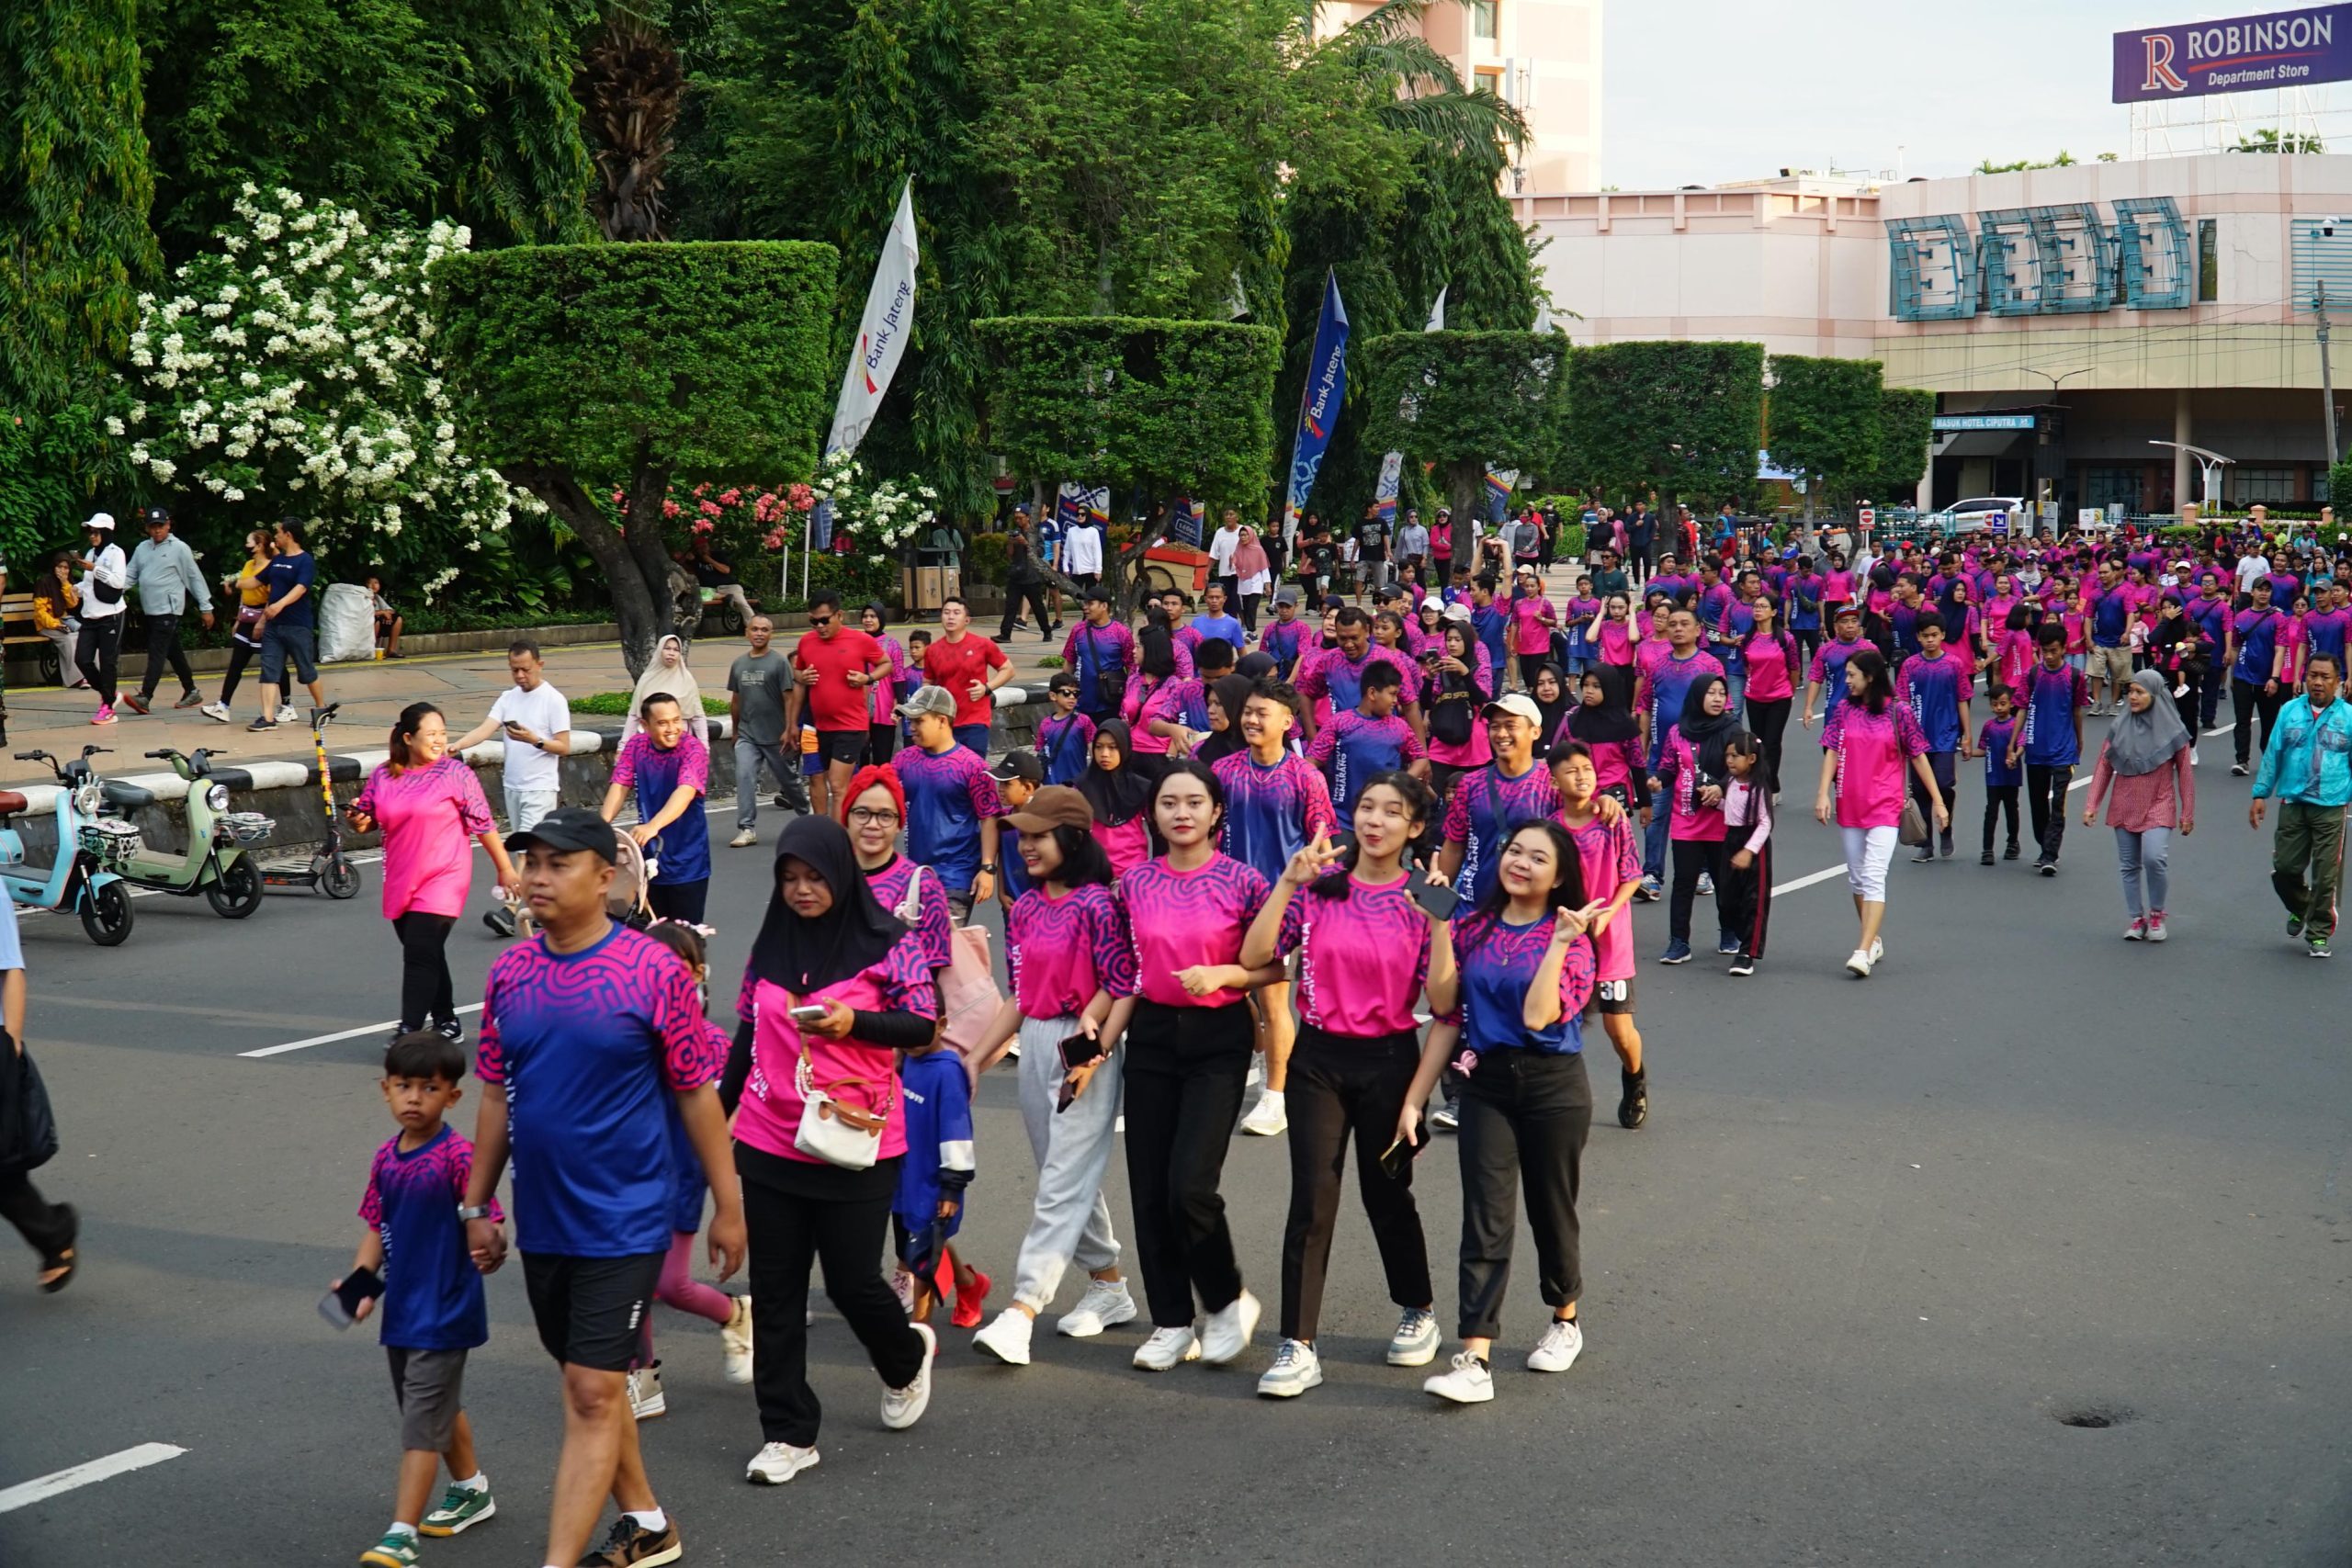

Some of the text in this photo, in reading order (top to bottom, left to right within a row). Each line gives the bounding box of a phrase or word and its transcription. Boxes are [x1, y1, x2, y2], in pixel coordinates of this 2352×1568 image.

[2187, 14, 2333, 61] ROBINSON
[2142, 34, 2188, 92] R
[2208, 63, 2310, 86] Department Store
[865, 279, 911, 370] Bank Jateng
[1309, 385, 1330, 420] Bank
[1936, 418, 2017, 428] MASUK HOTEL CIPUTRA
[2028, 704, 2037, 744] SEMARANG
[1338, 752, 1348, 802] SEMARANG
[1600, 979, 1627, 1002] 30
